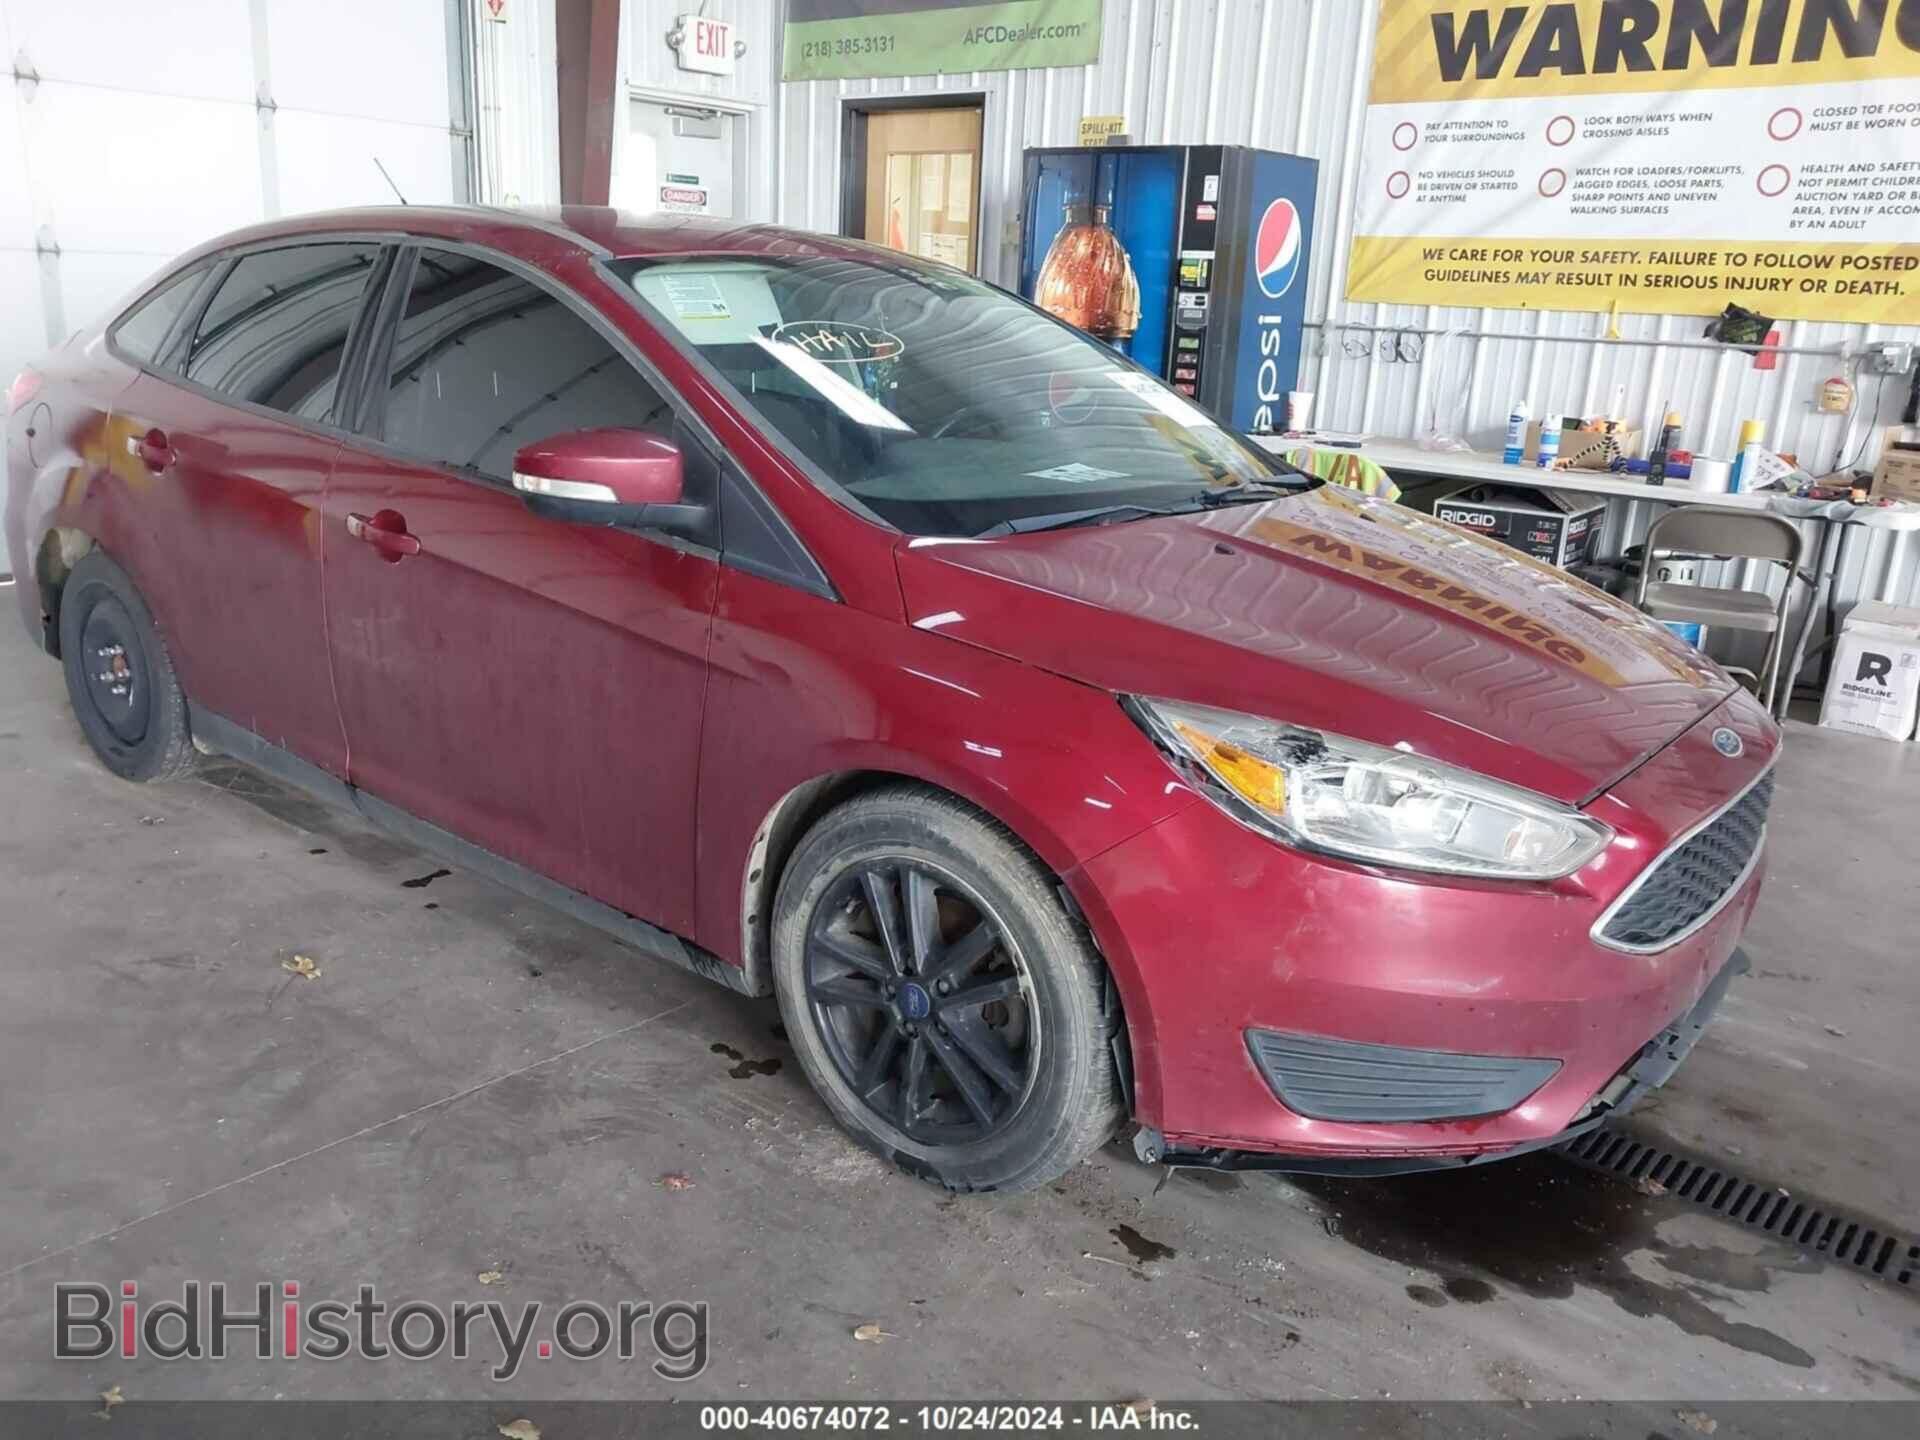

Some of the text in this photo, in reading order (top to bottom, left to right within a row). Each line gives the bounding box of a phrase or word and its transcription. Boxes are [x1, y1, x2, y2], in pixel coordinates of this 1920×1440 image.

[696, 21, 728, 57] EXIT
[801, 35, 896, 58] (218) 385-3131
[1812, 106, 1858, 118] CLOSED
[1862, 104, 1884, 115] TOE
[1584, 112, 1713, 126] LOOK BOTH WAYS WHEN
[1081, 122, 1123, 135] SPILL-KIT
[1425, 120, 1509, 131] PAY ATTENTION TO
[1809, 121, 1842, 132] MUST
[1845, 121, 1860, 131] BE
[1864, 118, 1906, 129] WORN
[1423, 132, 1526, 143] YOUR SURROUNDINGS
[1582, 127, 1670, 138] CROSSING AISLES
[1575, 165, 1746, 176] WATCH FOR LOADERS/FORKLIFTS,
[1800, 164, 1845, 174] HEALTH
[1847, 163, 1876, 173] AND
[1418, 170, 1515, 179] NO VEHICLES SHOULD
[1417, 182, 1518, 191] BE DRIVEN OR STARTED
[1572, 179, 1725, 189] JAGGED EDGES, LOOSE PARTS,
[1798, 178, 1823, 188] NOT
[1826, 177, 1869, 187] PERMIT
[1416, 195, 1467, 203] AT ANYTIME
[1571, 192, 1718, 202] SHARP POINTS AND UNEVEN
[1794, 192, 1848, 201] AUCTION
[1853, 191, 1884, 201] YARD
[1887, 191, 1906, 201] OR
[1569, 205, 1669, 215] WALKING SURFACES
[1792, 206, 1825, 216] AREA,
[1830, 206, 1860, 215] EVEN
[1863, 206, 1874, 215] IF
[1789, 220, 1867, 229] BY AN ADULT
[1422, 247, 1919, 271] WE CARE FOR YOUR SAFETY. FAILURE TO FOLLOW POSTED
[1424, 268, 1906, 296] GUIDELINES MAY RESULT IN SERIOUS INJURY OR DEATH.
[790, 329, 895, 352] HAIL
[1440, 510, 1497, 527] RIDGID
[1856, 651, 1893, 687] R
[1842, 682, 1893, 698] RIDGELINE
